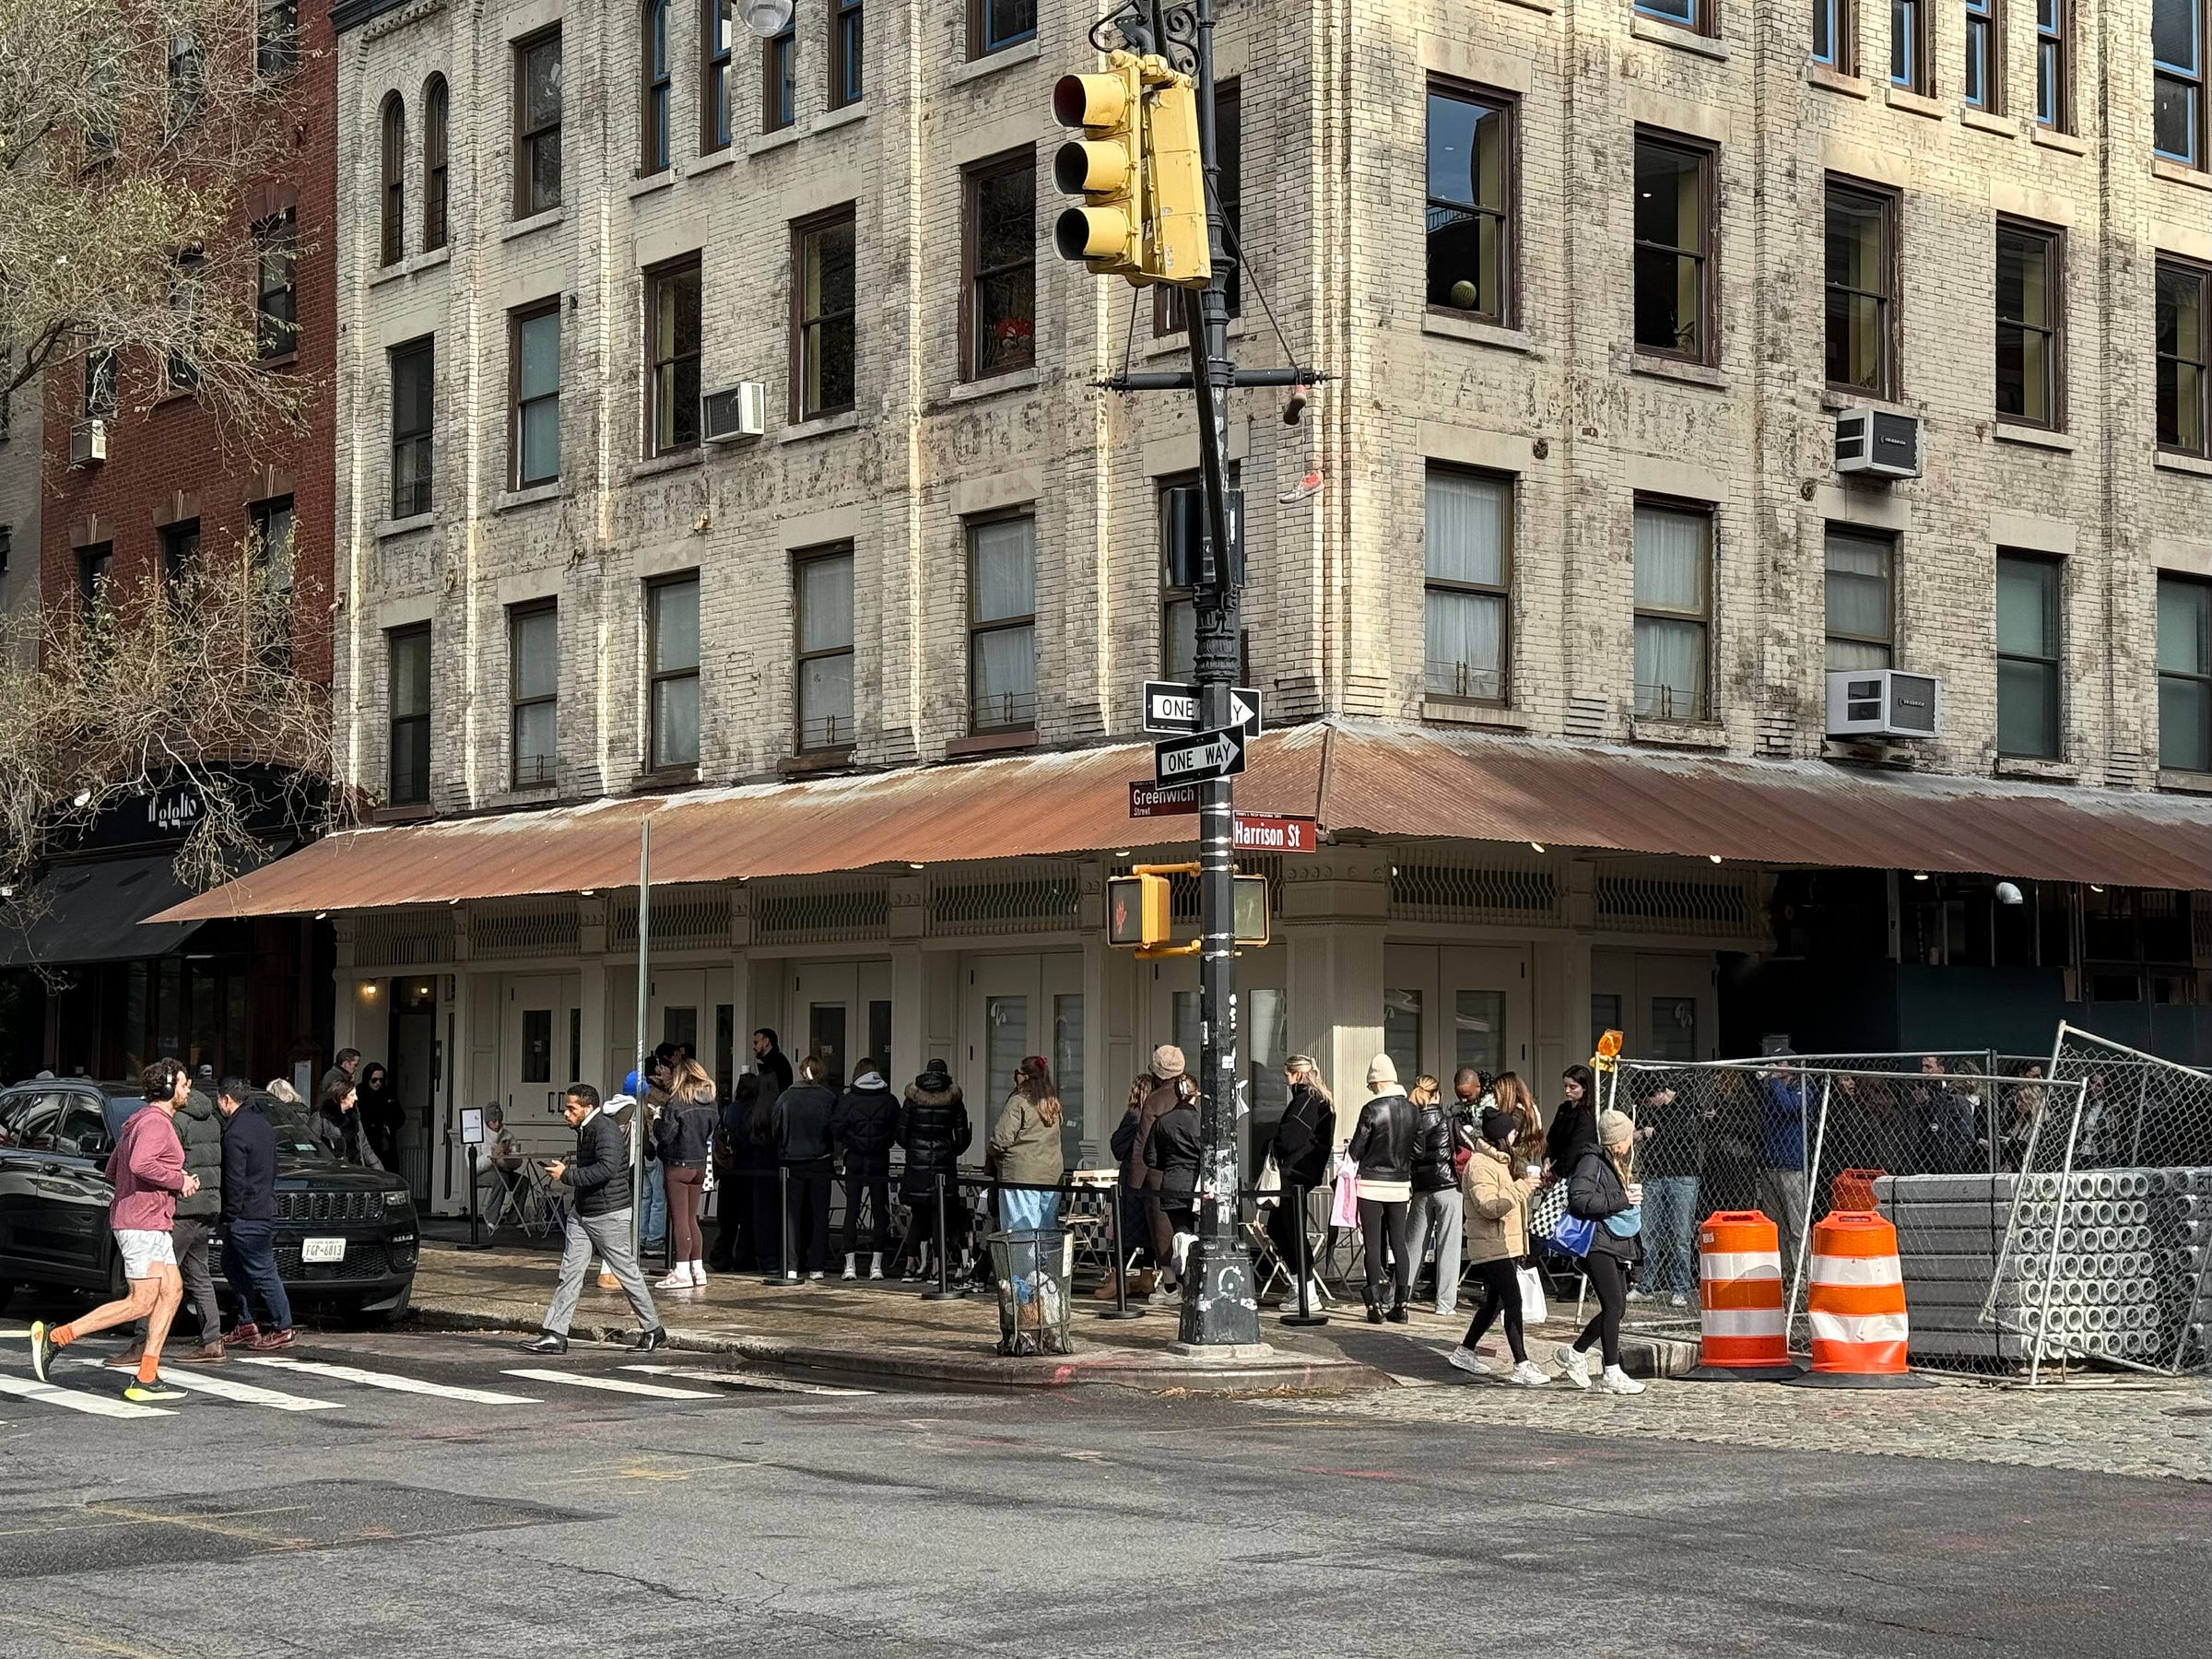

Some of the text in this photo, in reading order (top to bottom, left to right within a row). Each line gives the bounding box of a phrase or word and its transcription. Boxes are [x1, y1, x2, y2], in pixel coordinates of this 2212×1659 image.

[1162, 699, 1194, 719] ONE
[1168, 742, 1231, 772] ONE WAY
[1133, 786, 1194, 806] Greenwich
[147, 792, 197, 831] il giglio
[1133, 806, 1151, 817] Street
[1235, 820, 1300, 847] Harrison St
